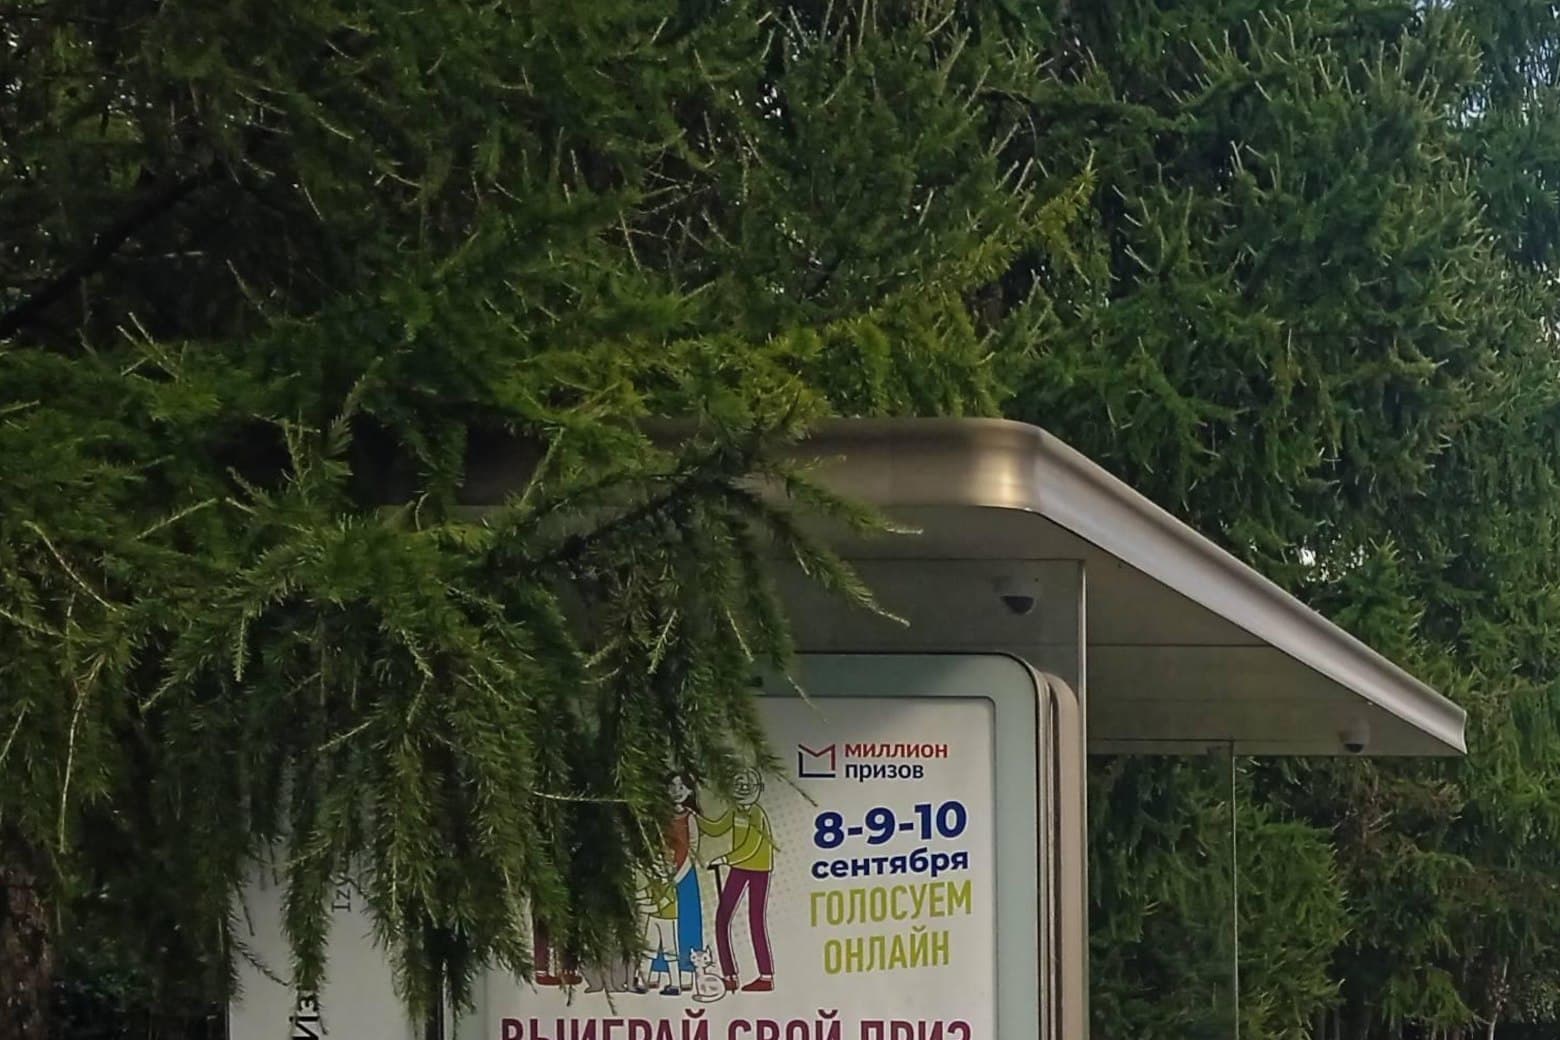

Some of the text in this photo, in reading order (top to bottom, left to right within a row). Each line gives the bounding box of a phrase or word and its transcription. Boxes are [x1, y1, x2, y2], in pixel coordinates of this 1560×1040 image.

[845, 764, 924, 782] призов
[813, 800, 968, 849] 8-9-10
[811, 847, 969, 880] сентября
[810, 879, 973, 928] ГОЛОСУЕМ
[823, 925, 950, 975] ОНЛАЙН
